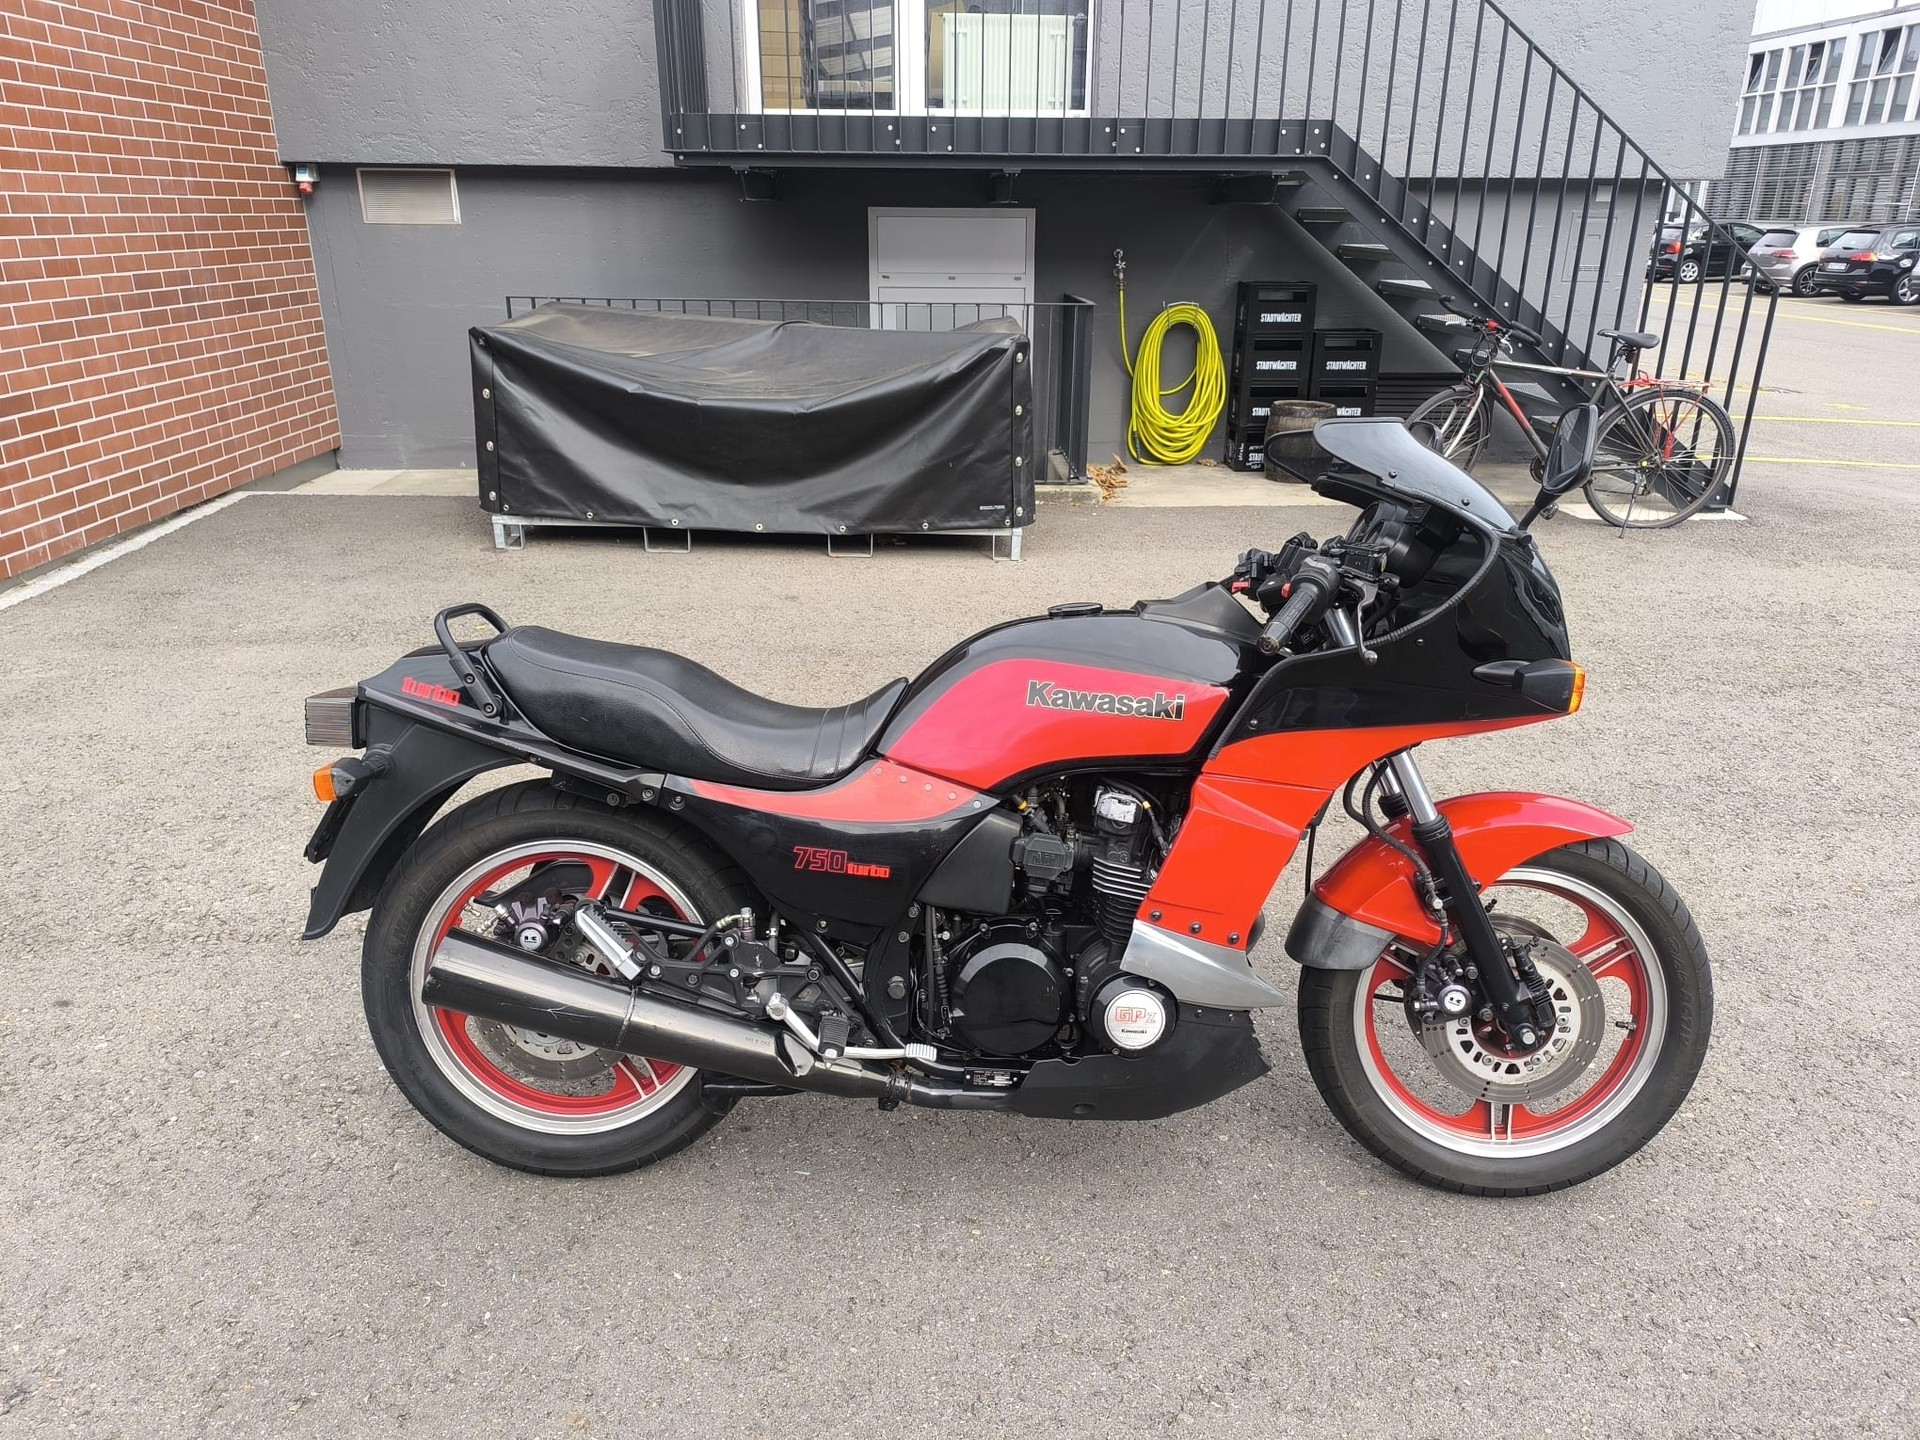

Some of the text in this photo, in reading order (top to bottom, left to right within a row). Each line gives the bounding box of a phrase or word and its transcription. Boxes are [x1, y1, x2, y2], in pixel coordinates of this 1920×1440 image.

[402, 676, 461, 707] turbo
[1025, 680, 1187, 721] Kawasaki
[793, 845, 890, 878] 750 turbo
